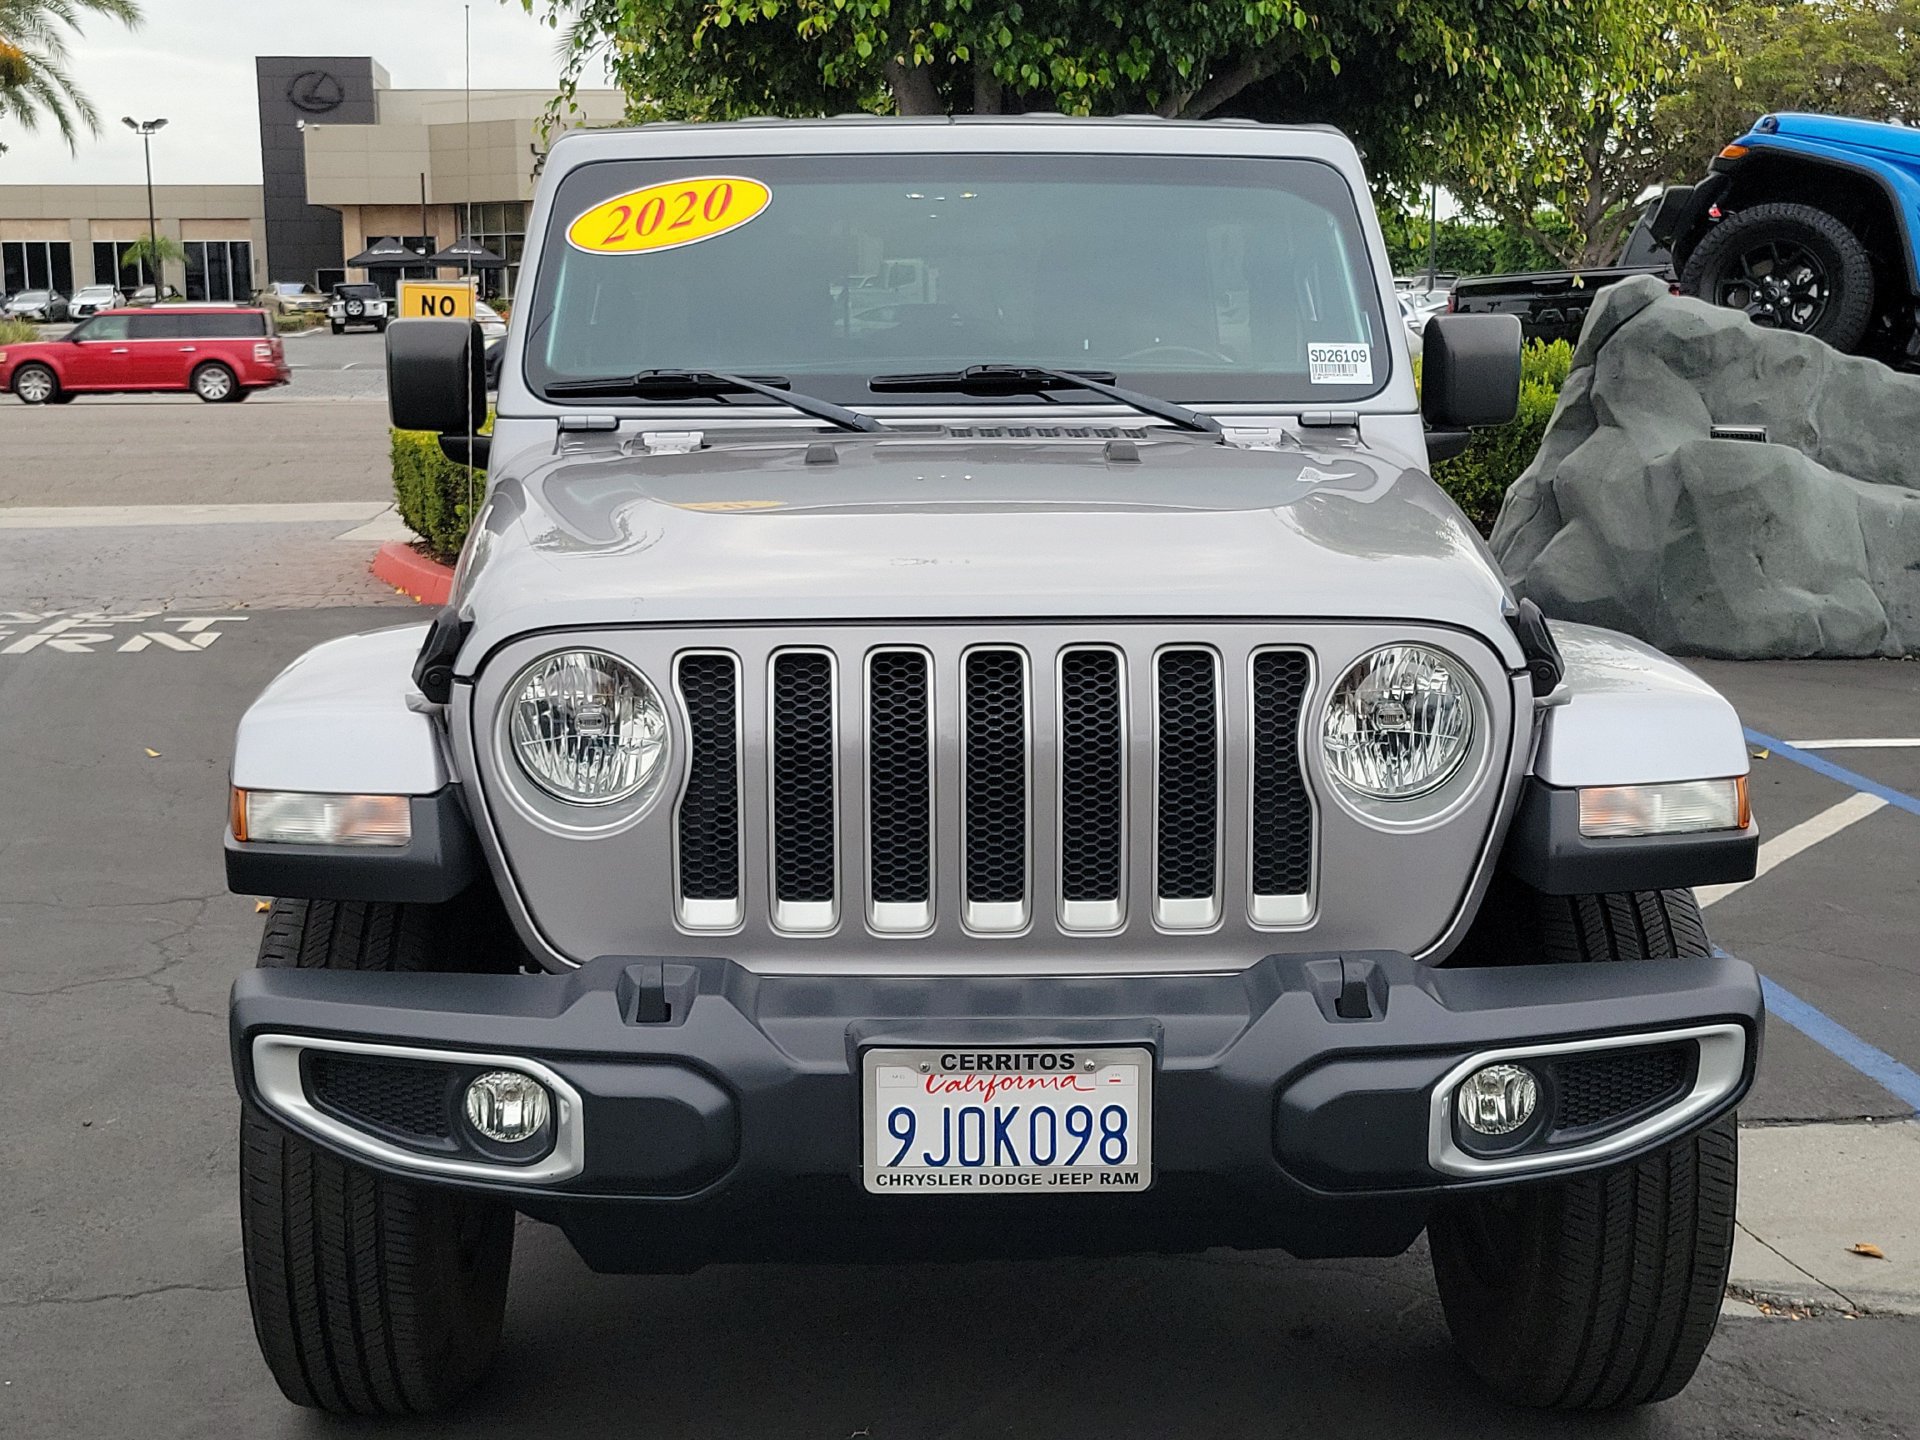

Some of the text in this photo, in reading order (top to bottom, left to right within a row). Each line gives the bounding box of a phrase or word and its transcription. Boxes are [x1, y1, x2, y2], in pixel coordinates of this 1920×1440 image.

[601, 183, 733, 245] 2020
[421, 295, 456, 317] NO
[1310, 349, 1368, 363] SD26109
[940, 1053, 1076, 1071] CERRITOS
[925, 1073, 1096, 1103] California
[876, 1172, 1139, 1187] CHRYSLER DODGE JEEP RAM
